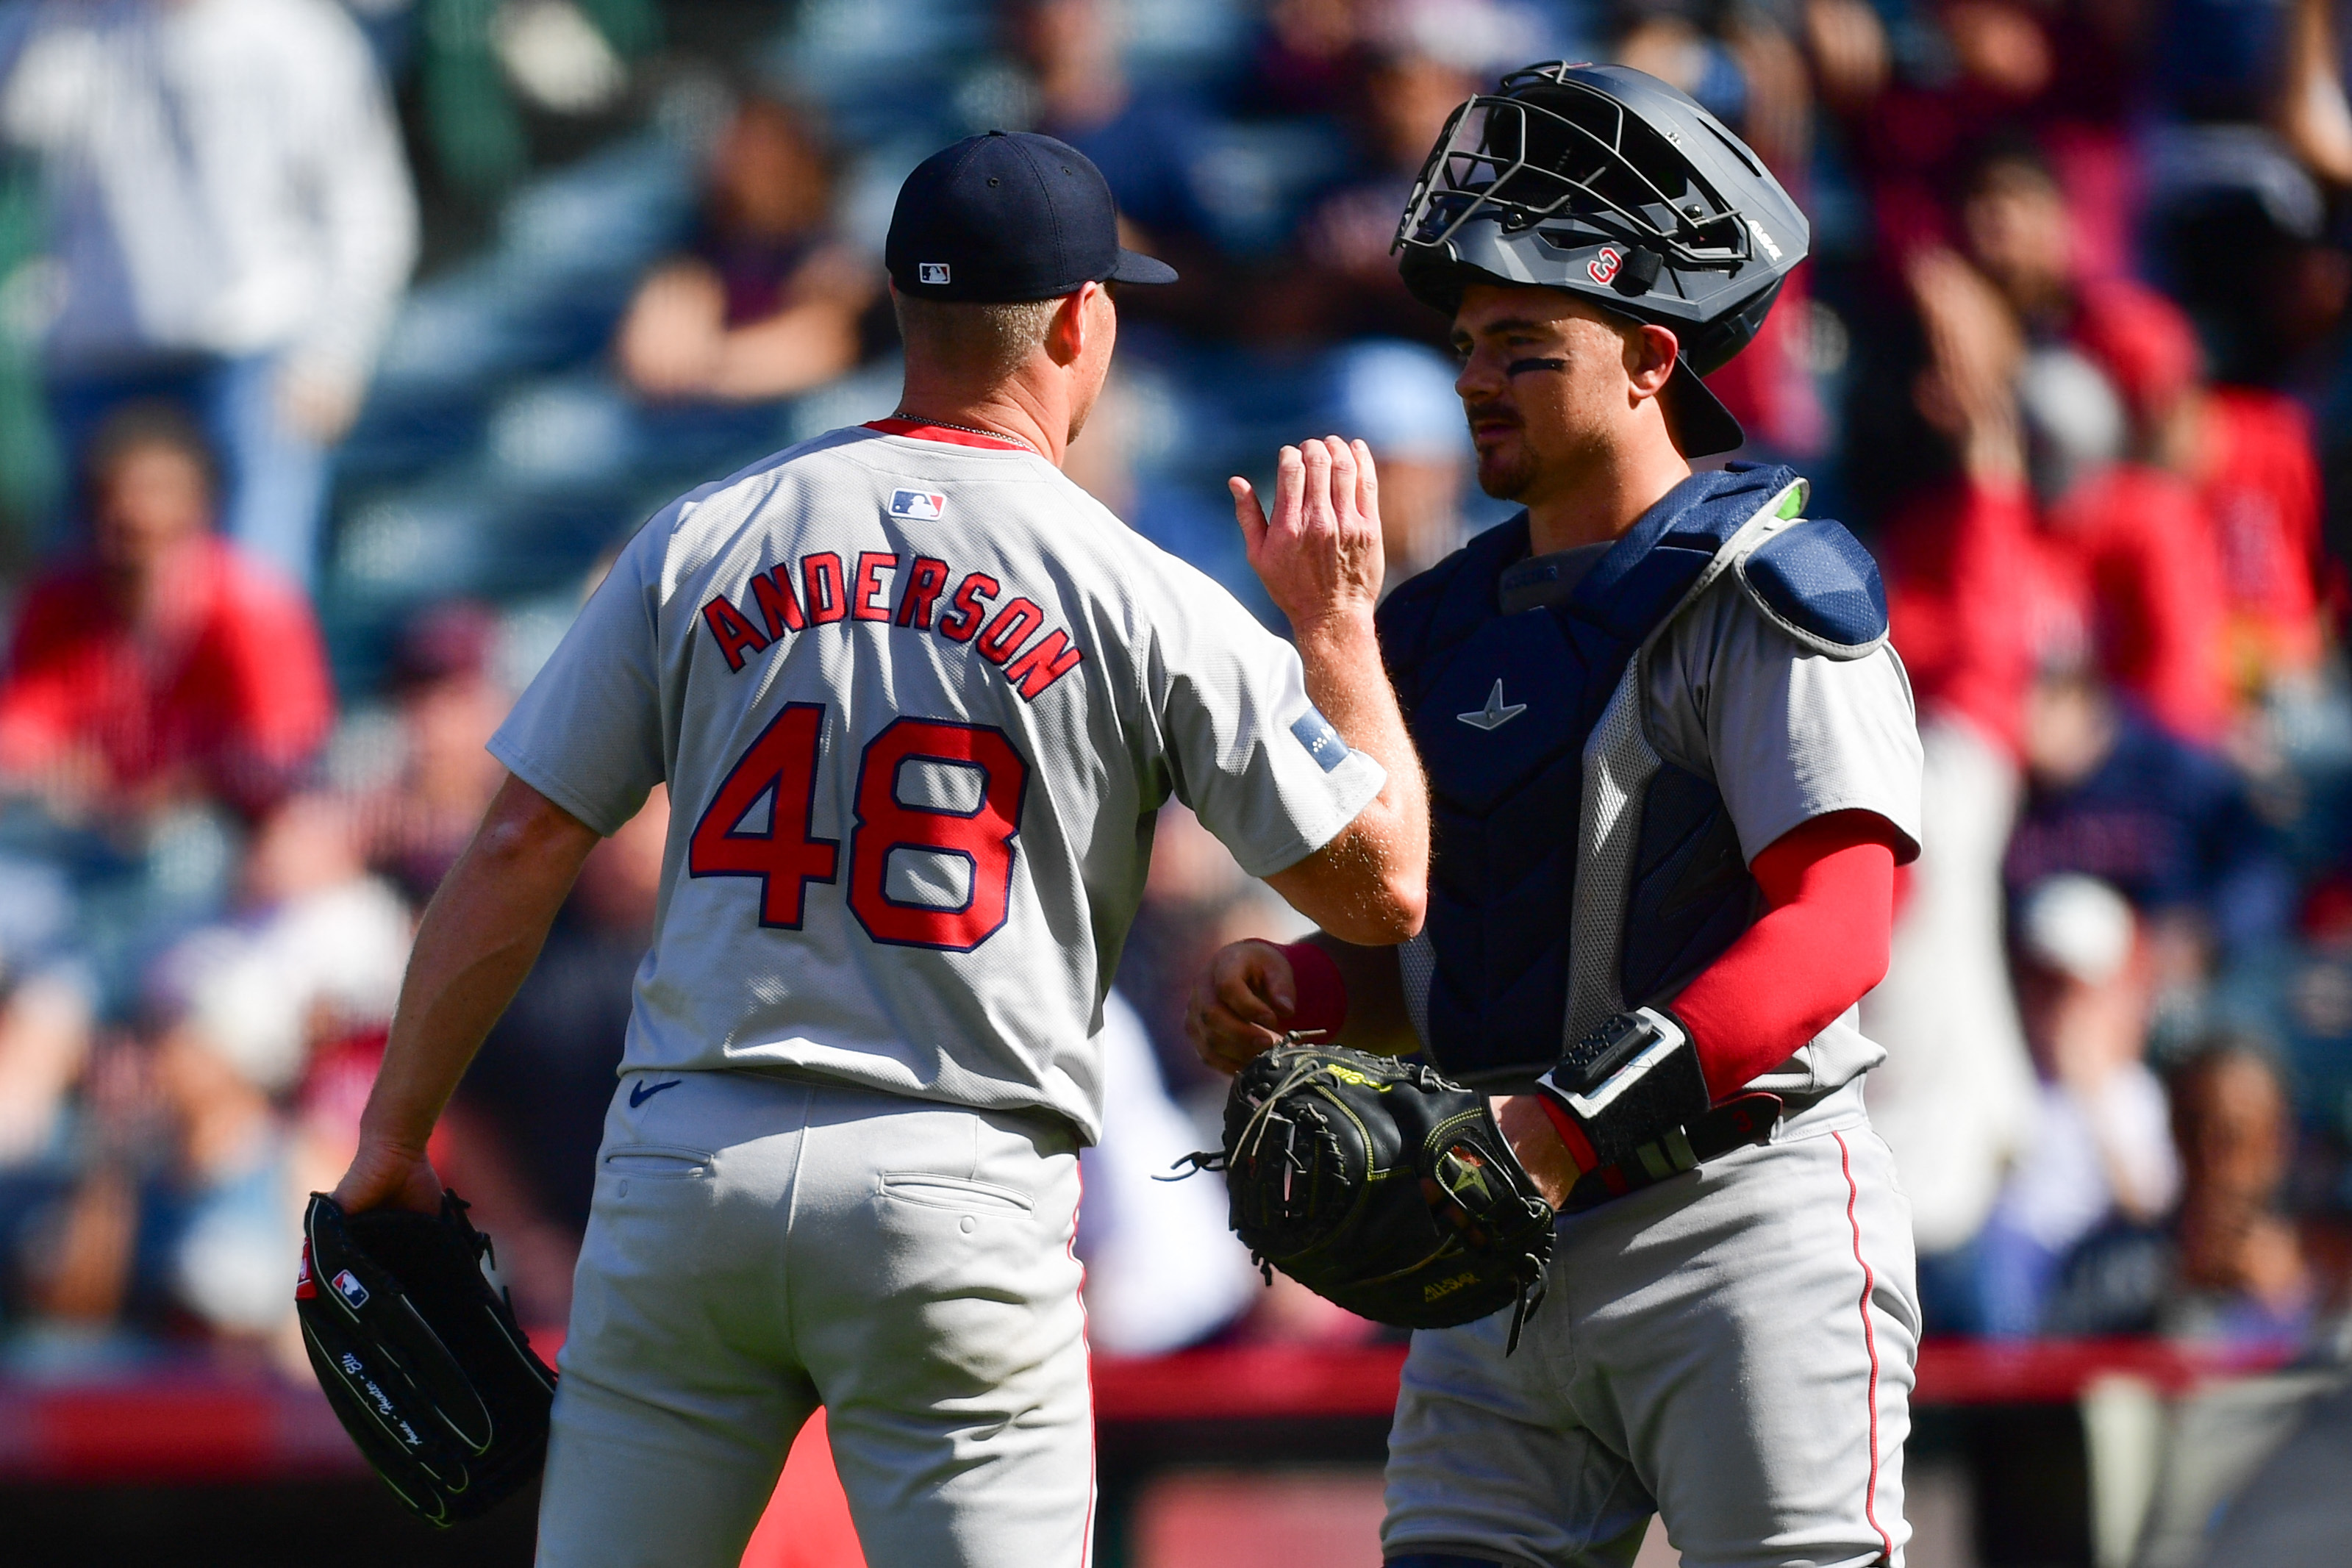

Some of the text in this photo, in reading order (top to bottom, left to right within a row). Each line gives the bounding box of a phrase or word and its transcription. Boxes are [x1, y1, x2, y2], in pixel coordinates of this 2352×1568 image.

[1587, 247, 1622, 285] 3
[702, 551, 1084, 703] ANDERSON
[689, 701, 1031, 953] 48
[1731, 1109, 1754, 1134] 3
